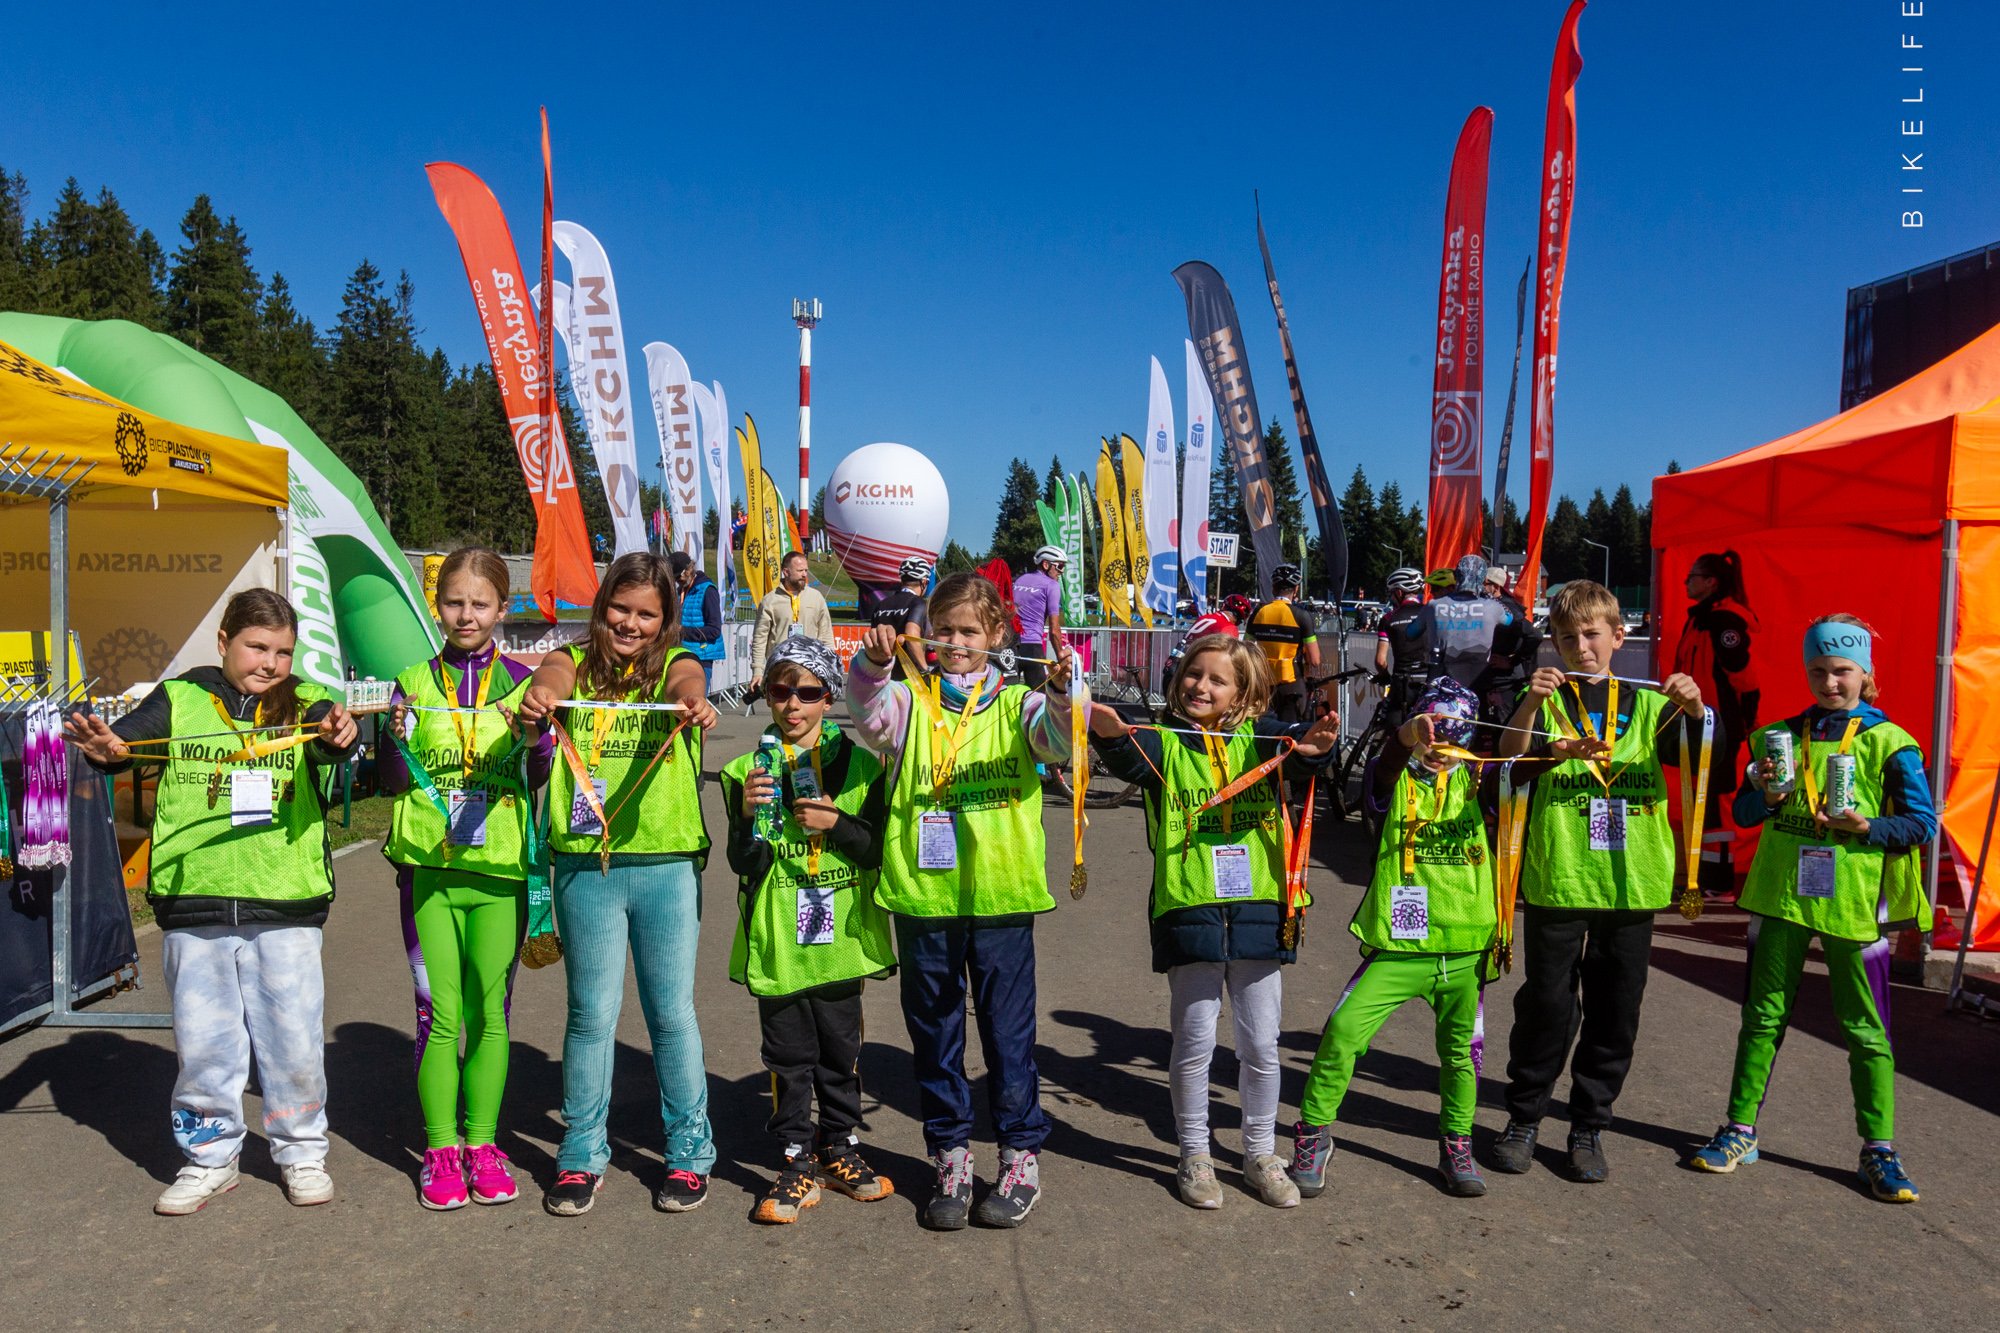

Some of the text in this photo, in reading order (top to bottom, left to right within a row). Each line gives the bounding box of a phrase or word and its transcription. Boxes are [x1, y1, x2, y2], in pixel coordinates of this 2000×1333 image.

[1438, 225, 1464, 374] Jedynka
[1466, 234, 1480, 366] POLSKIE RADIO
[856, 484, 914, 498] KGHM
[1210, 537, 1234, 555] START
[1835, 765, 1846, 808] COCONAUT
